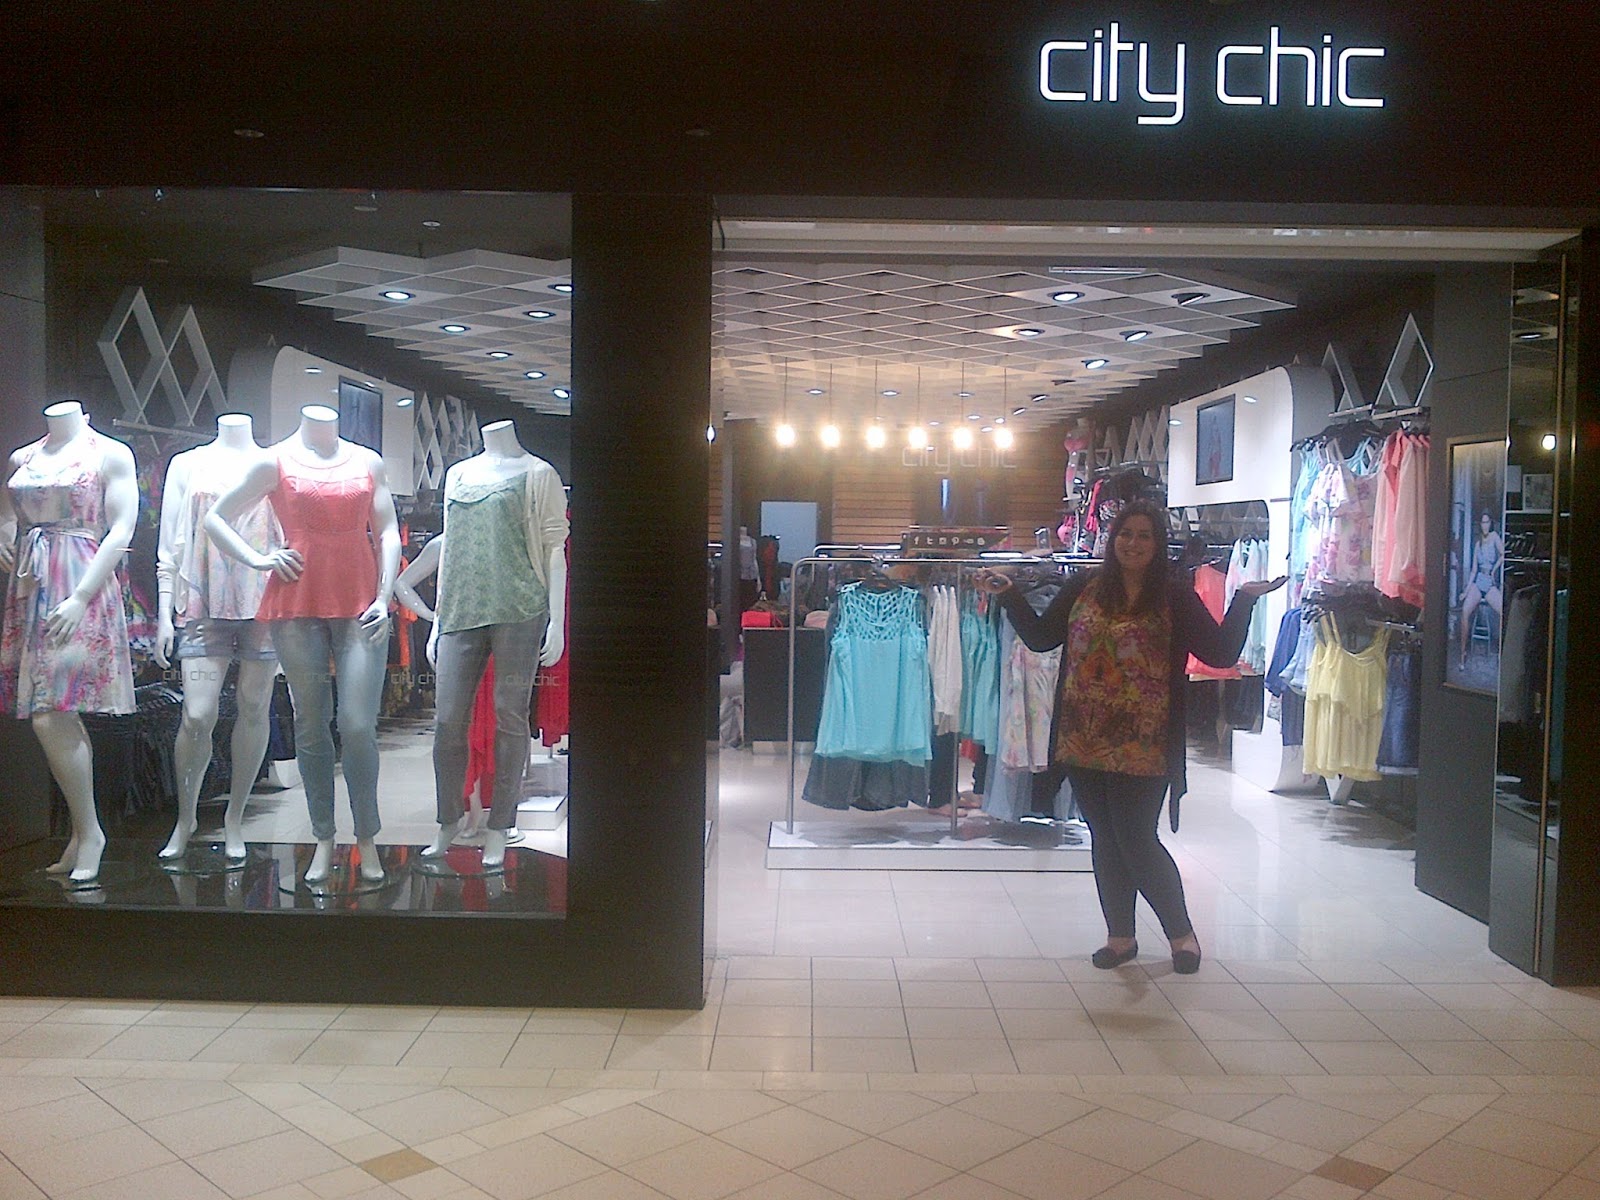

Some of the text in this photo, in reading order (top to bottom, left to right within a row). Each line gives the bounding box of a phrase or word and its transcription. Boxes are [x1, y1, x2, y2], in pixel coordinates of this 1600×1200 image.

[1039, 22, 1385, 125] city chic
[902, 437, 1017, 475] city chic
[190, 669, 217, 681] chic
[418, 671, 448, 685] chc
[534, 674, 560, 687] chic
